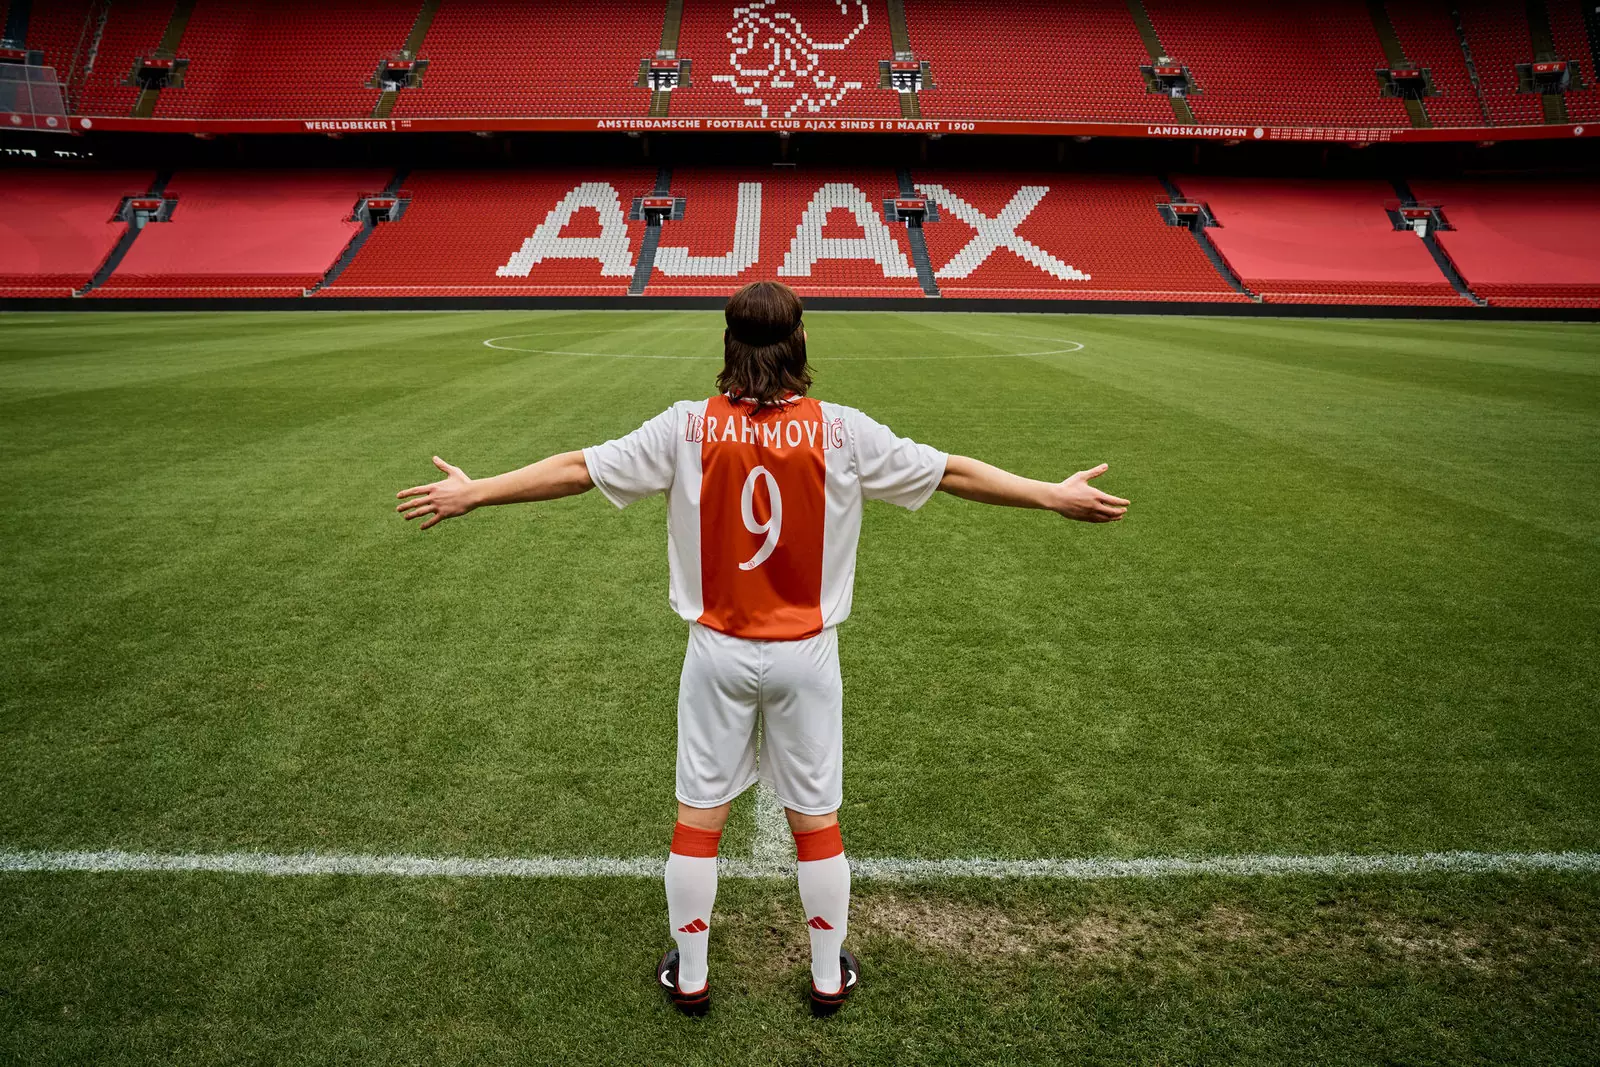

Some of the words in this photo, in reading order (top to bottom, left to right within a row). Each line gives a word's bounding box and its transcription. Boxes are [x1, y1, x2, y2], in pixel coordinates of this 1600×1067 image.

[304, 121, 388, 131] WERELDBEKER
[597, 120, 700, 129] AMSTERDAMSCHE
[706, 120, 766, 129] FOOTBALL
[770, 120, 800, 129] CLUB
[804, 121, 836, 130] AJAX
[840, 121, 875, 130] SINDS
[880, 122, 893, 130] 18
[897, 122, 940, 131] MAART
[948, 122, 976, 131] 1900
[1148, 126, 1247, 137] LANDSKAMPIOEN
[496, 182, 1091, 280] AJAX
[738, 465, 783, 571] 9
